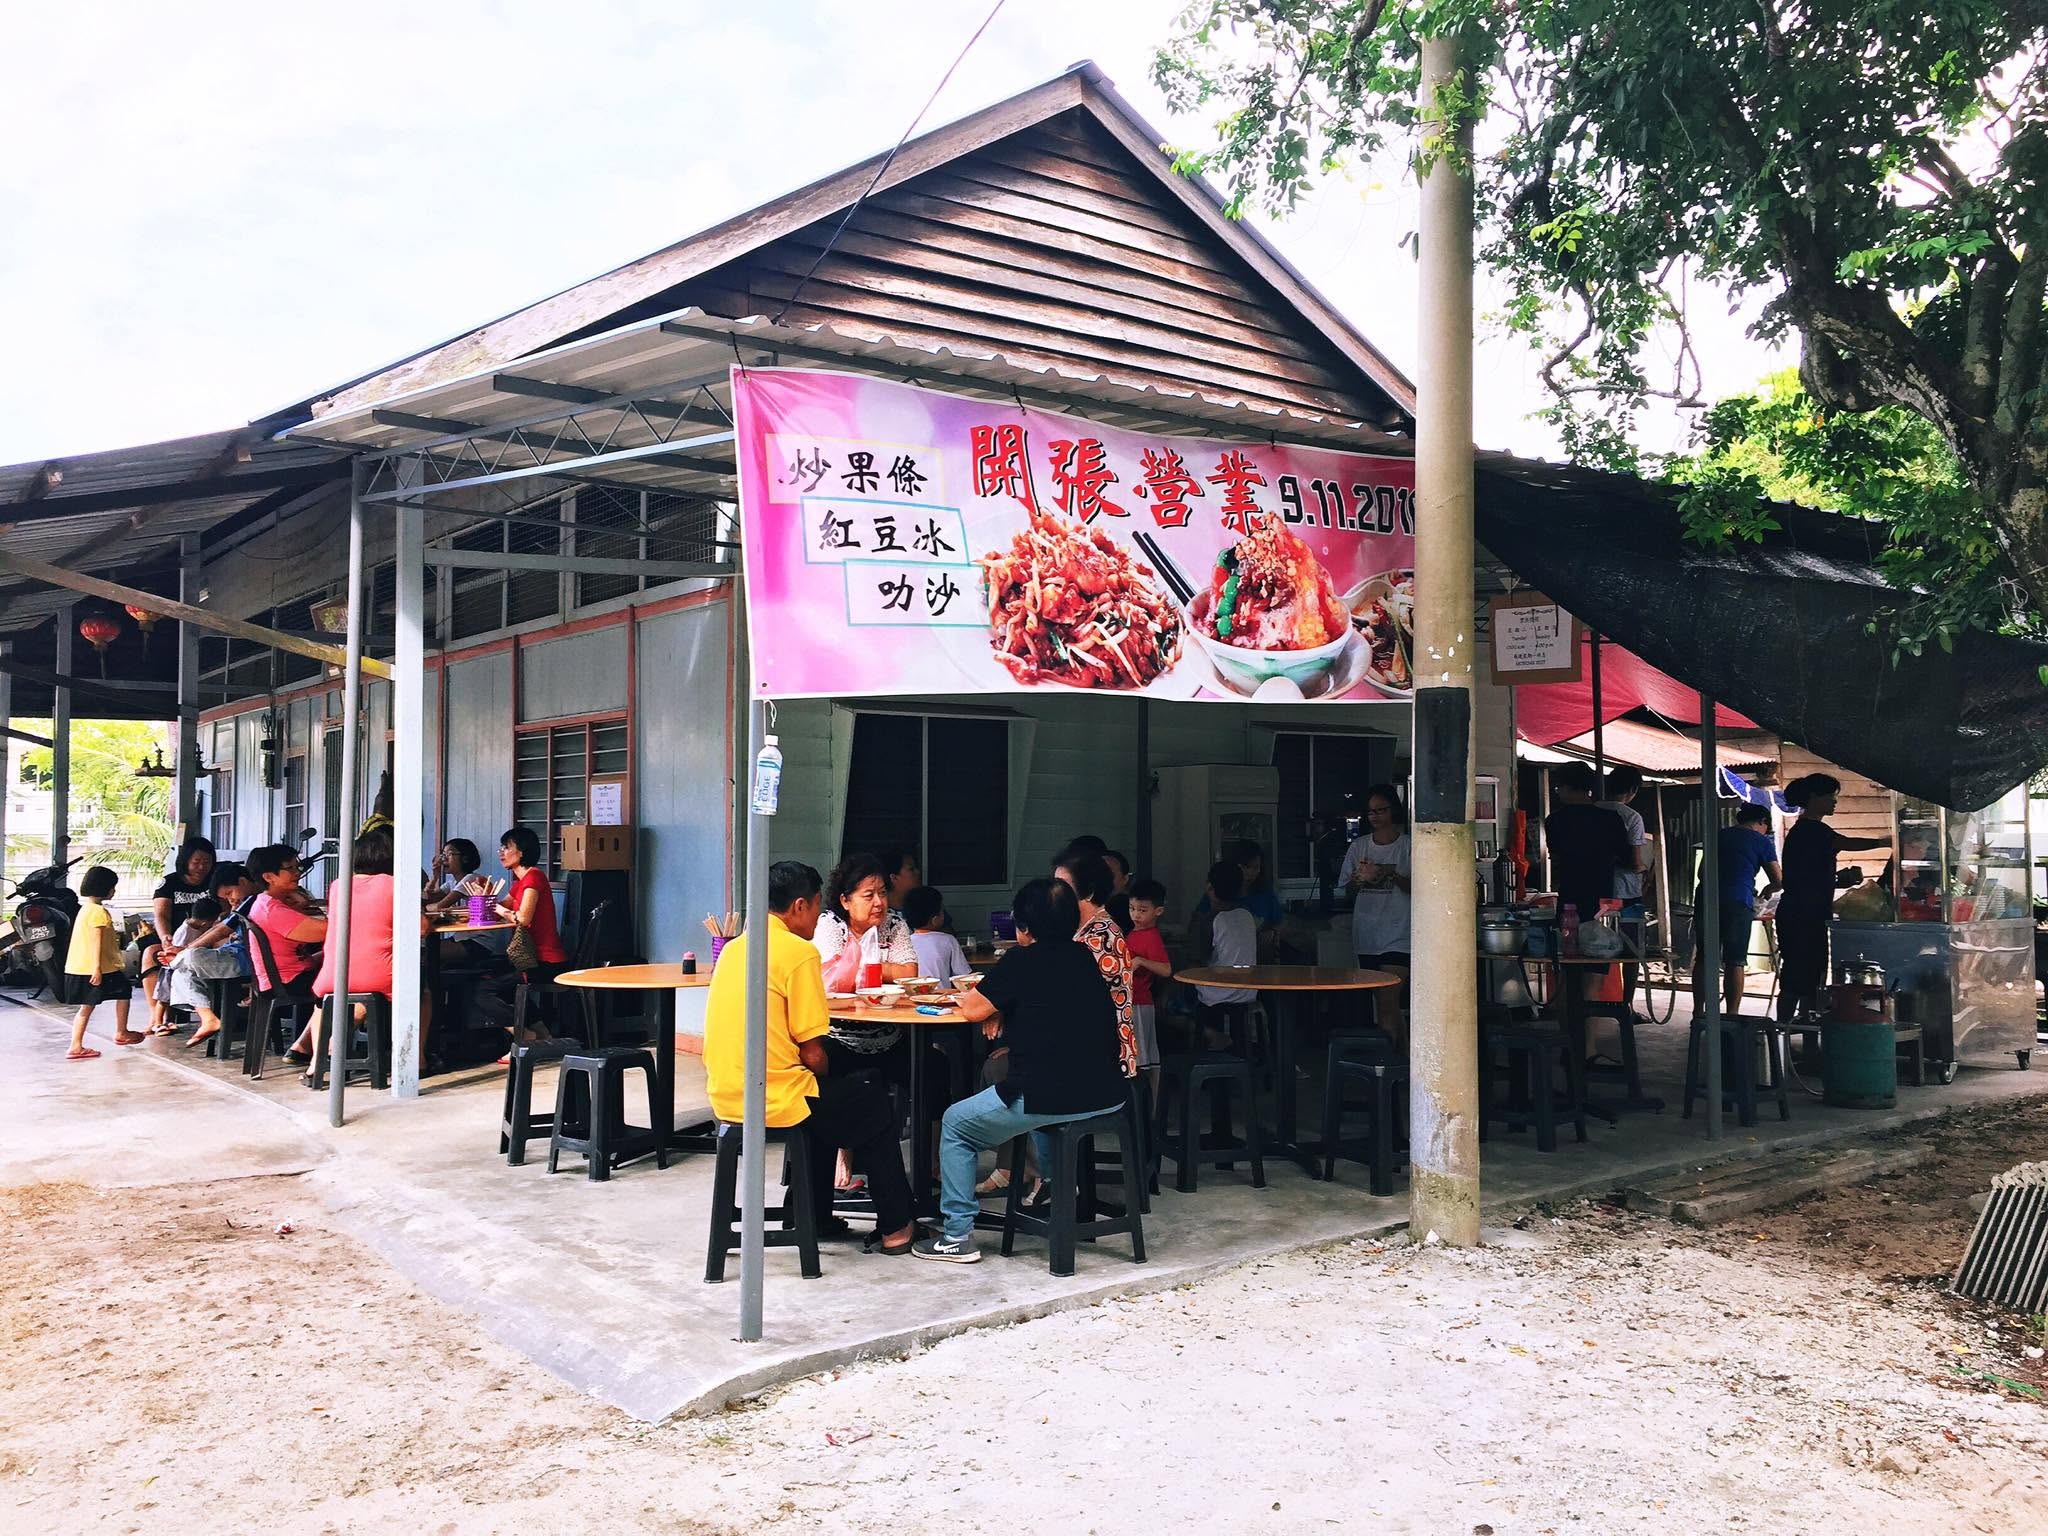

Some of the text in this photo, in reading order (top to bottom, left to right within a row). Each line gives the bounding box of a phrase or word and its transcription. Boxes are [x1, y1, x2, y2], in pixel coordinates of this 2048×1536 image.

[779, 447, 928, 496] 炒果條
[970, 424, 1267, 537] 開張營業
[1277, 474, 1415, 536] 9.11.201
[819, 510, 956, 557] 紅豆冰
[878, 573, 961, 616] 叻沙
